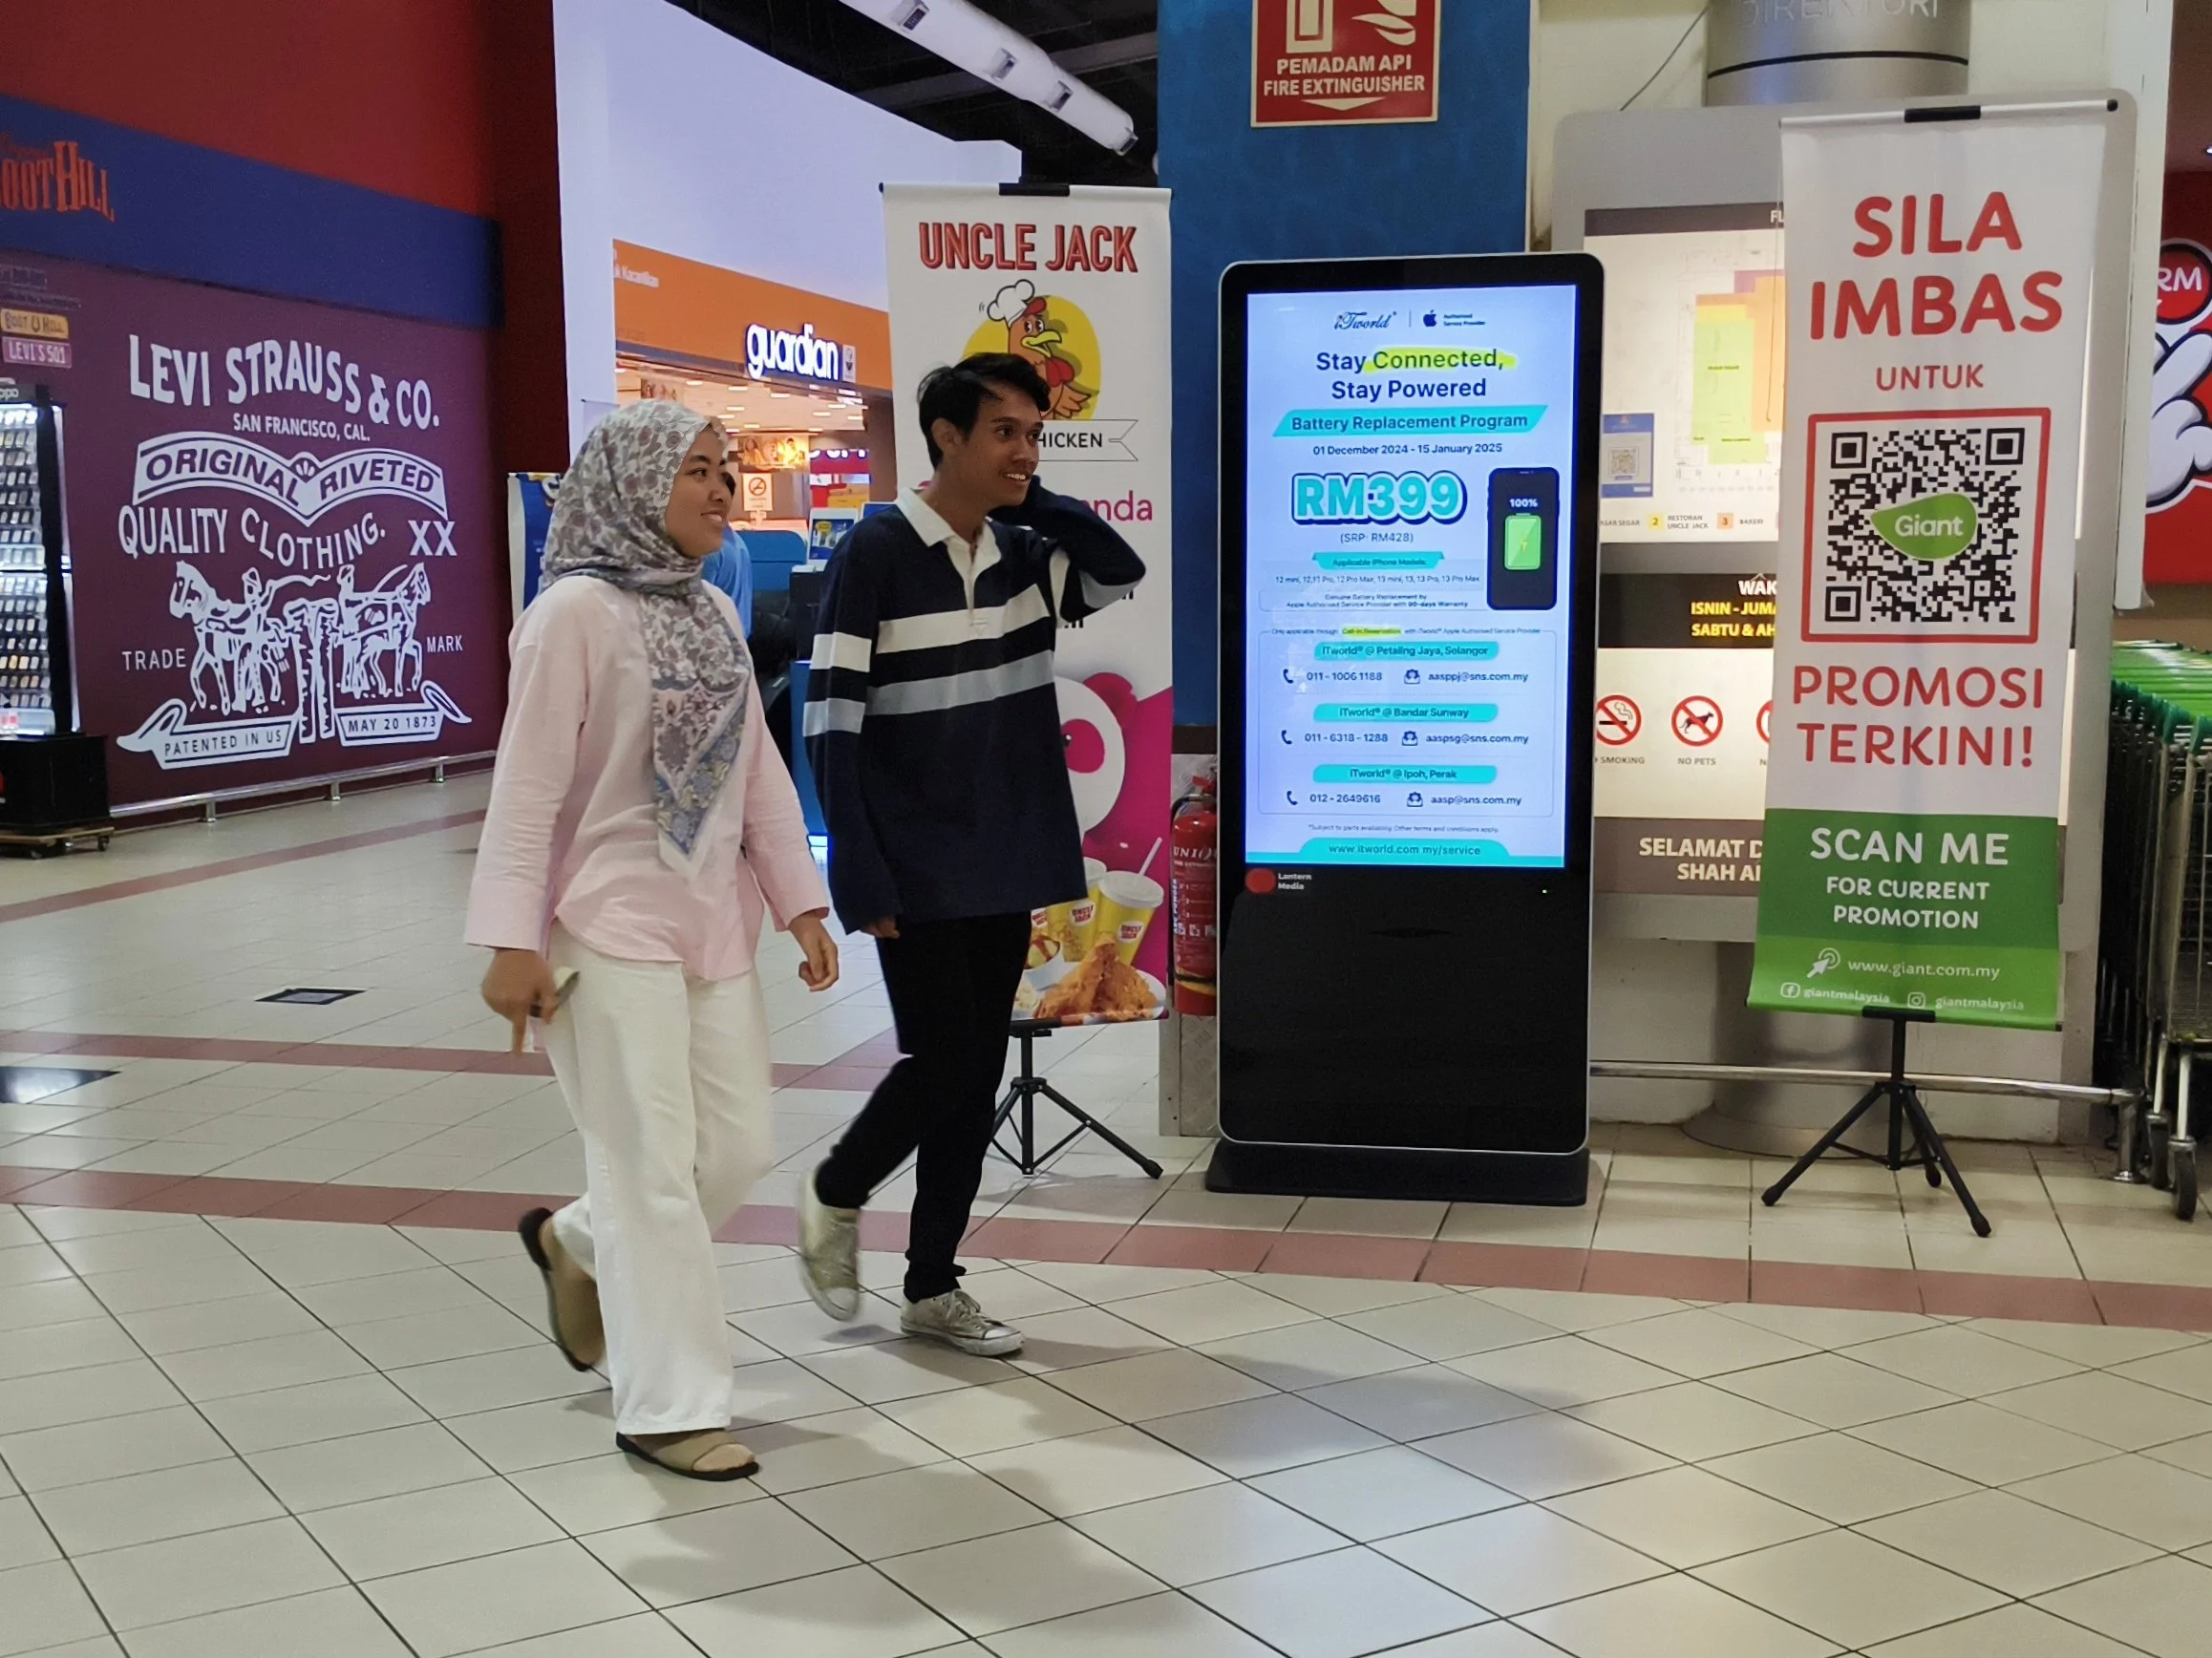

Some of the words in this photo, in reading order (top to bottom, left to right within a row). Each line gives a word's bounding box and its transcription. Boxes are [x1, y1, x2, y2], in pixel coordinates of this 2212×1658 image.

[1277, 55, 1375, 74] PEMADAM
[1378, 54, 1412, 71] API
[1264, 79, 1299, 96] FIRE
[1302, 75, 1425, 95] EXTINGUISHER
[1853, 191, 2022, 258] SILA
[919, 223, 1036, 270] UNCLE
[1045, 225, 1138, 272] JACK
[1810, 269, 2063, 340] IMBAS
[747, 323, 839, 379] guardian
[1316, 351, 1367, 373] Stay
[1373, 350, 1504, 370] Connected,
[129, 334, 210, 405] LEVI
[226, 339, 360, 414] STRAUSS
[368, 374, 392, 425] &
[395, 380, 439, 430] CO.
[1876, 364, 1985, 392] UNTUK
[1331, 381, 1381, 402] Stay
[1388, 379, 1486, 399] Powered
[233, 413, 263, 433] SAN
[266, 414, 341, 440] FRANCISCO,
[344, 420, 371, 441] CAL.
[1292, 417, 1349, 433] Battery
[1352, 416, 1456, 432] Replacement
[1460, 414, 1528, 430] Program
[1313, 446, 1326, 456] 01
[1328, 446, 1378, 456] December
[1381, 445, 1408, 455] 2024
[1417, 445, 1430, 454] 15
[1432, 444, 1473, 457] January
[1475, 443, 1502, 453] 2025
[146, 448, 299, 507] ORIGINAL
[320, 459, 435, 502] RIVETED
[1081, 490, 1152, 521] nda
[1291, 470, 1468, 525] RM399
[1509, 499, 1538, 507] 100%
[1652, 518, 1659, 526] 2
[1721, 517, 1729, 526] 3
[1895, 514, 1964, 540] Giant
[118, 505, 227, 559] QUALITY
[241, 507, 386, 569] CLOTHING.
[409, 521, 457, 556] XX
[1691, 602, 1732, 615] ISNIN
[1691, 624, 1739, 637] SABTU
[1741, 624, 1754, 637] &
[427, 635, 462, 653] MARK
[1376, 647, 1415, 657] Petaling
[1418, 646, 1443, 657] Jaya,
[1445, 646, 1488, 657] Selangor
[122, 648, 186, 671] TRADE
[1793, 666, 2043, 711] PROMOSI
[349, 717, 377, 733] MAY
[384, 716, 400, 731] 20
[405, 714, 436, 730] 1873
[1393, 708, 1428, 716] Bandar
[1430, 708, 1469, 718] Sunway
[164, 733, 241, 756] PATENTED
[245, 732, 260, 749] IN
[266, 729, 283, 745] US
[1305, 733, 1321, 742] 011
[1797, 722, 2032, 768] TERKINI!
[1601, 756, 1645, 765] SMOKING
[1694, 757, 1716, 766] PETS
[1430, 770, 1457, 778] Perak
[1639, 838, 1745, 858] SELAMAT
[1810, 827, 1923, 864] SCAN
[1941, 832, 2010, 866] ME
[1677, 863, 1734, 882] SHAH
[1826, 876, 1872, 896] FOR
[1878, 878, 1989, 901] CURRENT
[1834, 904, 1979, 930] PROMOTION
[1847, 959, 2000, 982] www.giant.com.my
[1803, 988, 1890, 1004] giantmalaysia
[1935, 996, 2024, 1011] giantmalaysia
